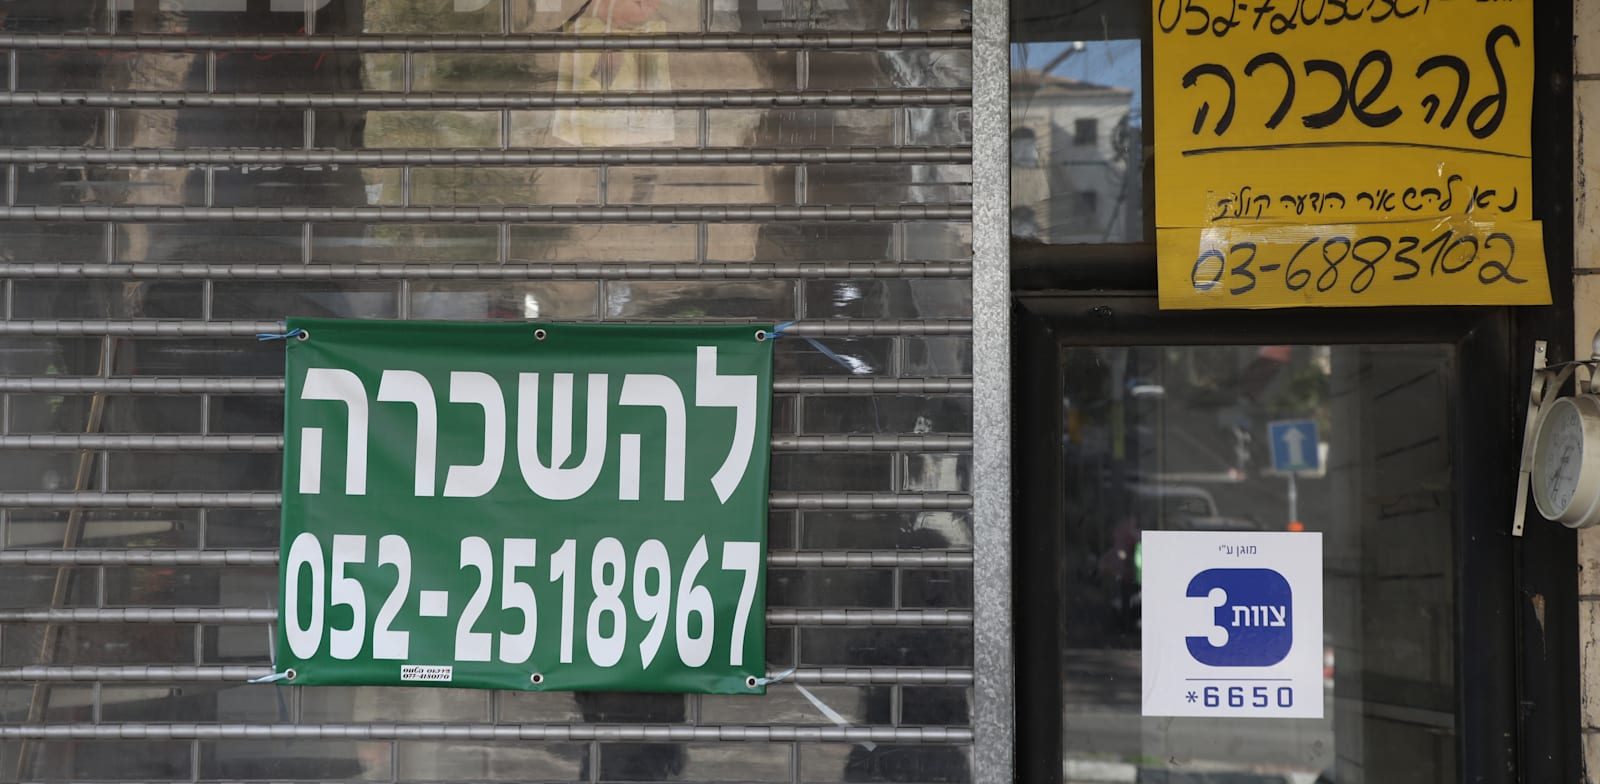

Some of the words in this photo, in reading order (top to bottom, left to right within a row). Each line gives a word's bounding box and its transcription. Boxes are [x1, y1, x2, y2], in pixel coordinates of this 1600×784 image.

[1182, 25, 1520, 139] להשכרה
[1280, 192, 1346, 215] הודעה
[1356, 174, 1462, 212] להשאיר
[1466, 185, 1518, 214] נא
[1191, 231, 1528, 295] 03-6883102
[299, 346, 758, 505] להשכרה
[1218, 544, 1233, 555] ע"י
[1236, 545, 1257, 558] מוגן
[285, 532, 761, 670] 052-2518967
[1231, 605, 1286, 627] צוות
